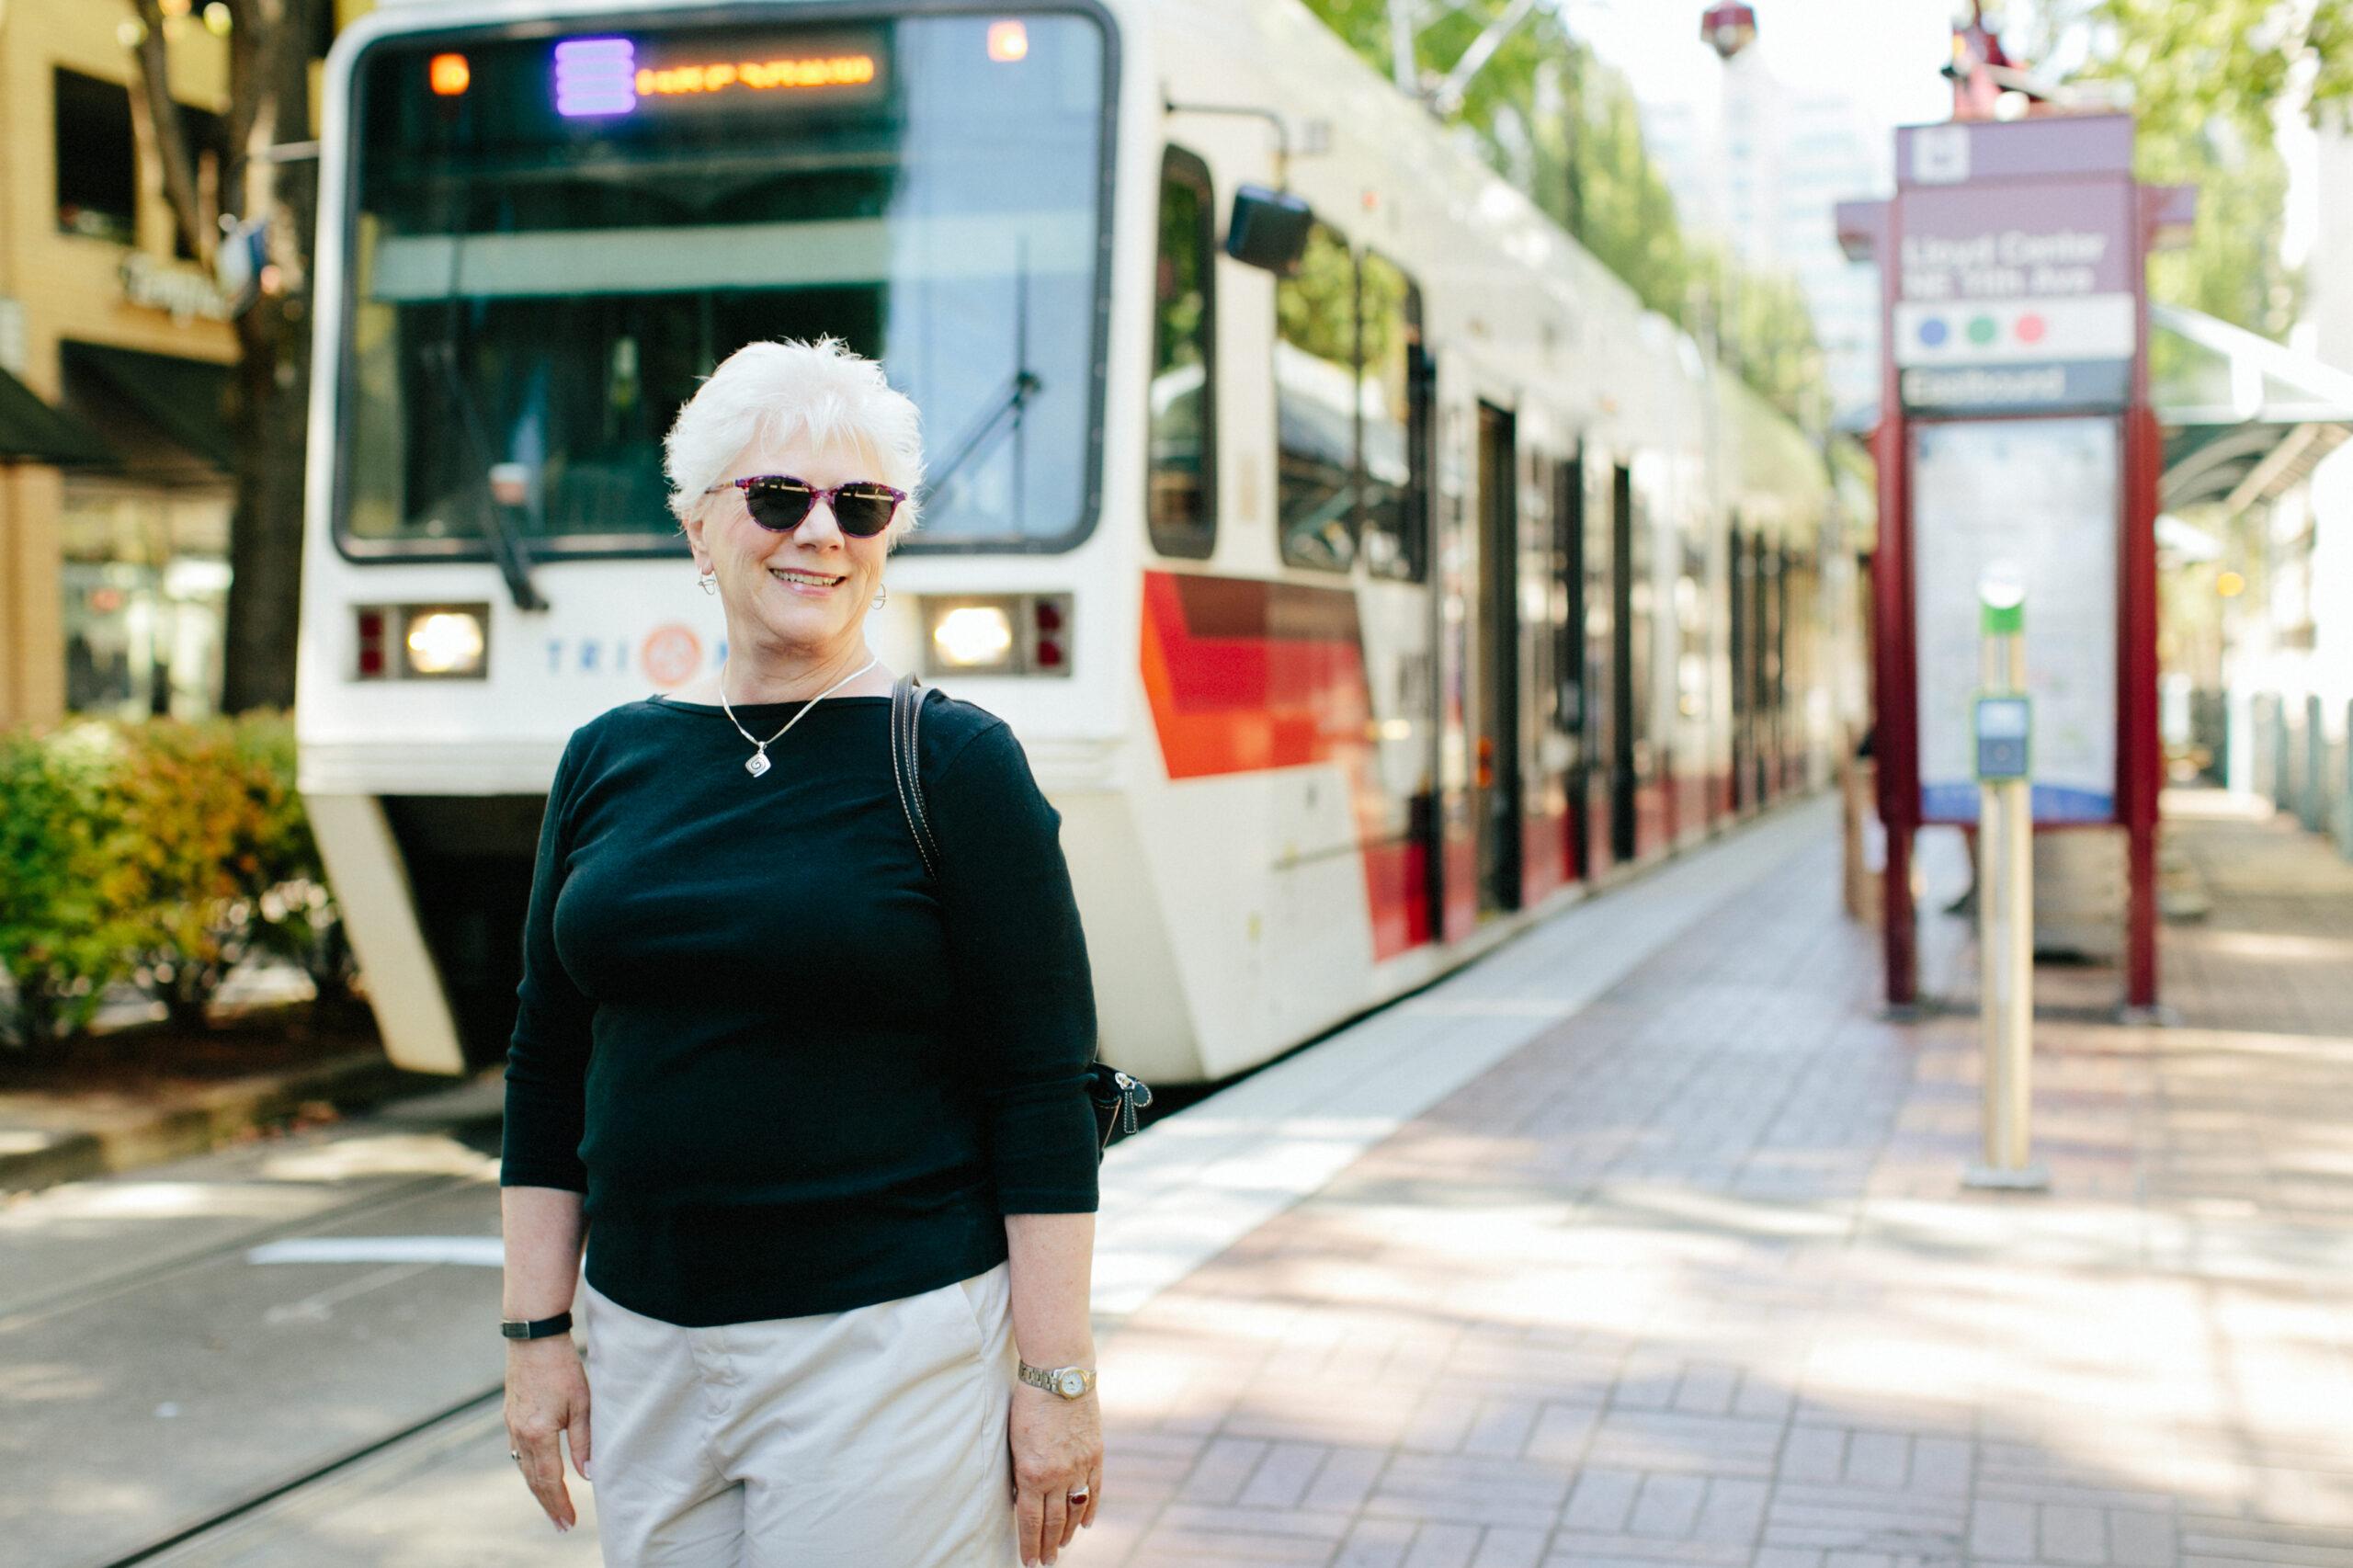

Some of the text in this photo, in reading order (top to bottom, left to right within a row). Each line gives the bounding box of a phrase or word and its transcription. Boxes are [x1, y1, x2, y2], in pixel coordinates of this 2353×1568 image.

[1902, 229, 2107, 271] Lloyd Center
[1902, 368, 2064, 405] Eastbound
